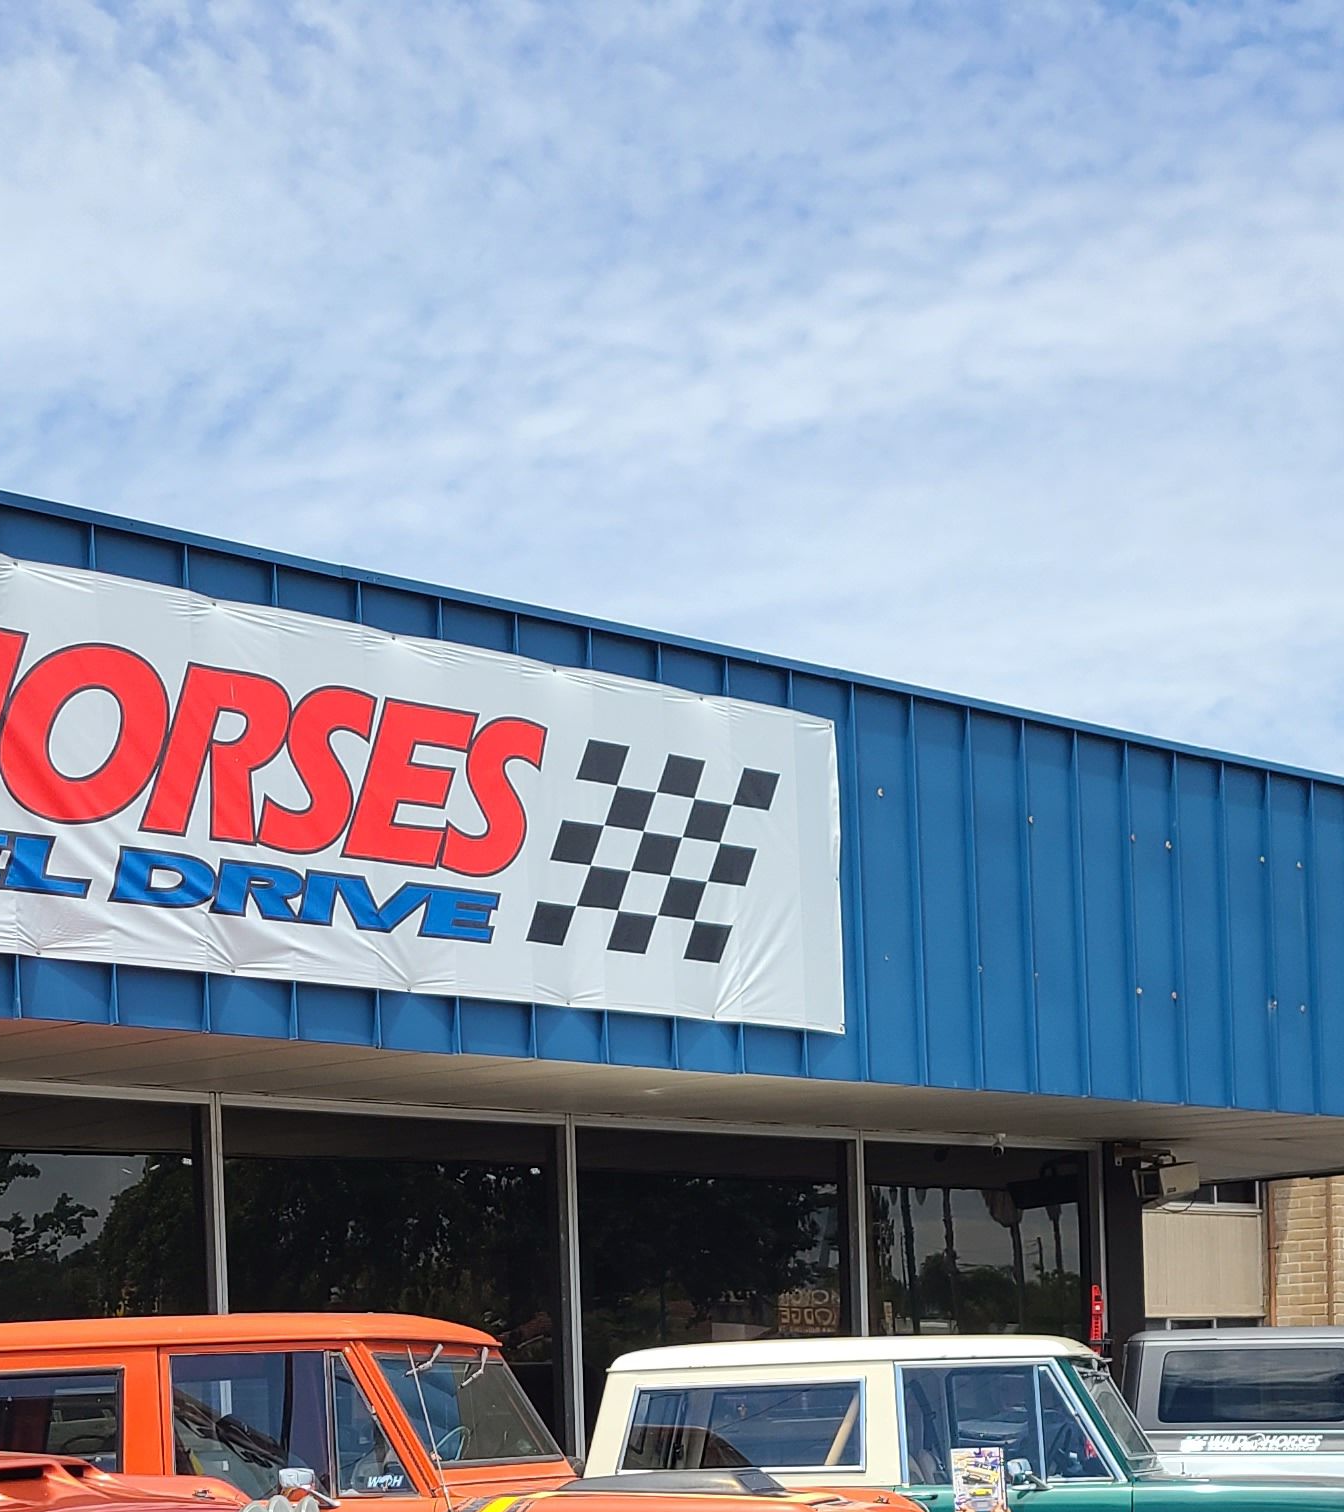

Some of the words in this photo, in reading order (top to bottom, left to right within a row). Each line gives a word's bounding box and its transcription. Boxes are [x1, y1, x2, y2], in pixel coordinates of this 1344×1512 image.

[107, 846, 501, 944] DRIVE
[1207, 1435, 1248, 1449] WILD
[1263, 1434, 1323, 1449] HORSES
